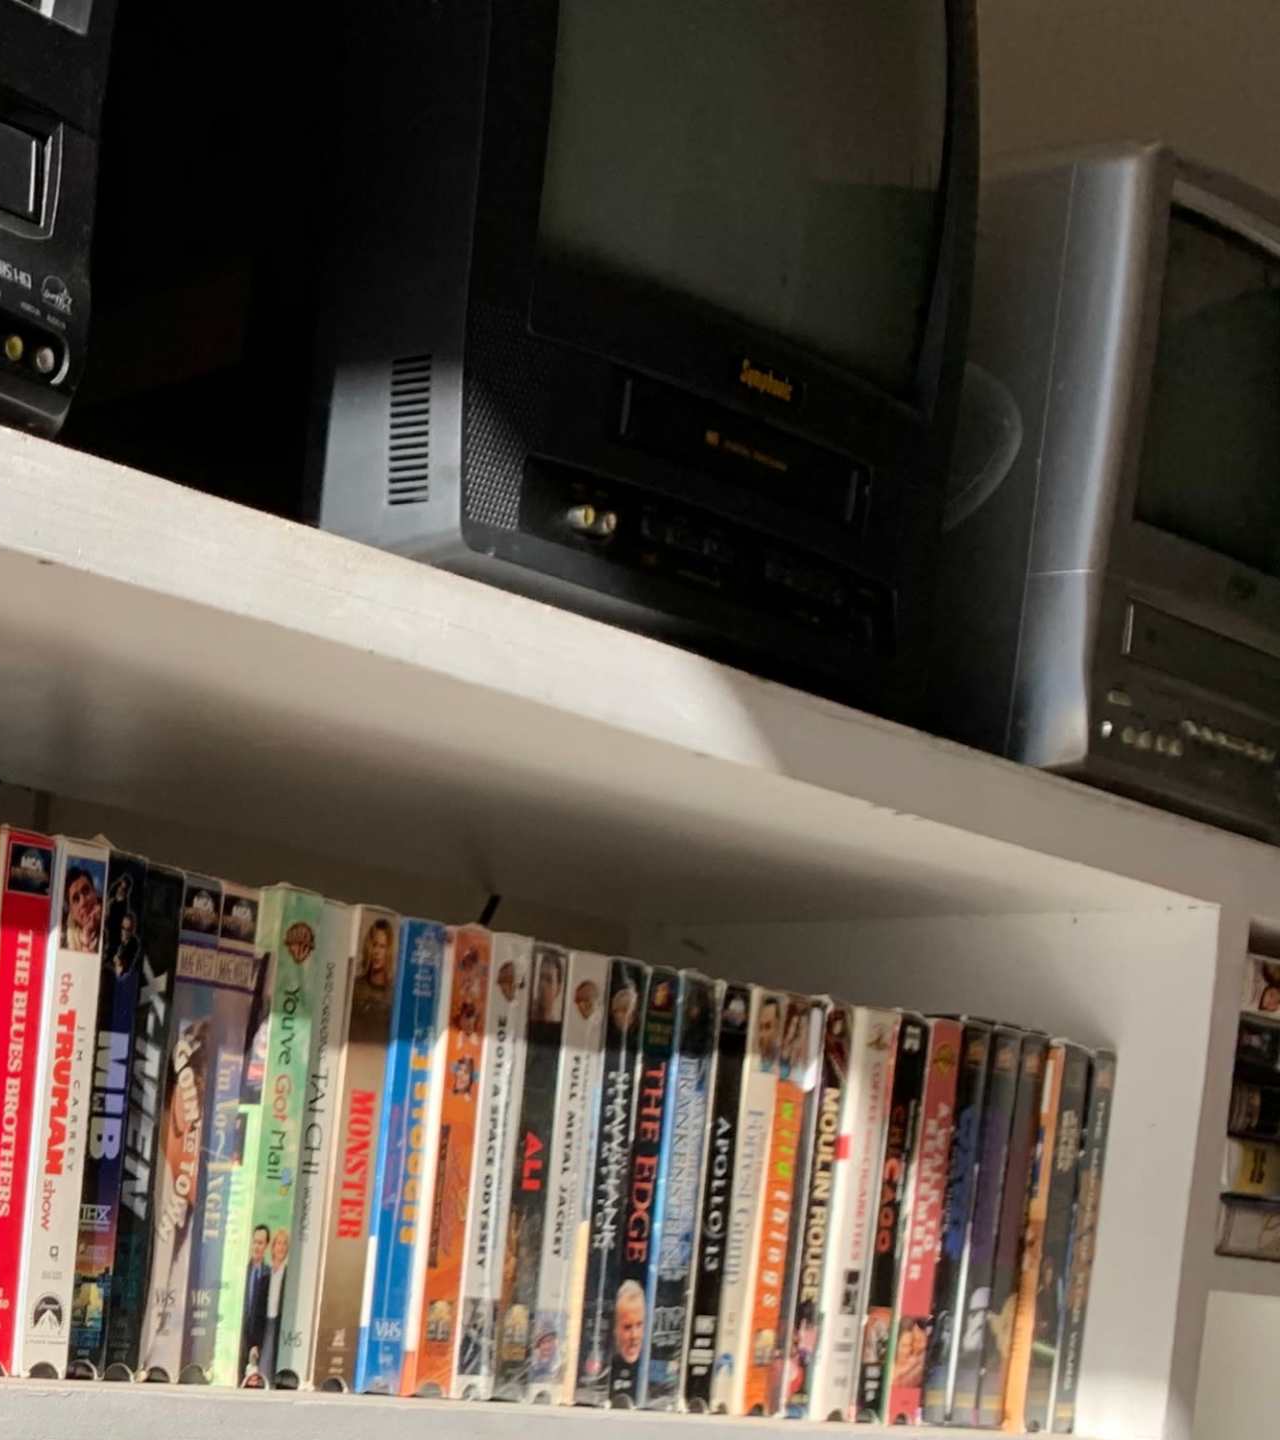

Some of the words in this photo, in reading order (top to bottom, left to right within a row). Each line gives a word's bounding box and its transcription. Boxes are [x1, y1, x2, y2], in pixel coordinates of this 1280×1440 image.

[13, 929, 33, 986] THE
[59, 972, 74, 1005] the
[7, 989, 28, 1073] BLUES
[76, 1024, 87, 1061] JIM
[44, 1010, 77, 1176] TRUMAN
[121, 954, 168, 1221] X-MEN
[271, 1072, 292, 1122] Got
[306, 1072, 329, 1114] TAI
[493, 1082, 502, 1099] A
[569, 1055, 581, 1100] FULL
[640, 1061, 667, 1143] THE
[67, 1079, 80, 1172] CARREY
[266, 1129, 286, 1182] Mail
[301, 1121, 323, 1177] CHI
[485, 1103, 501, 1170] SPACE
[520, 1129, 544, 1192] ALI
[560, 1110, 578, 1176] METAL
[776, 1101, 795, 1178] wild
[812, 1086, 841, 1200] MOULIN
[336, 1088, 377, 1241] MONSTER
[661, 1057, 700, 1272] FRANKENSTEIN
[705, 1115, 732, 1239] APOLLO
[877, 1105, 905, 1254] CHICAGO
[41, 1179, 56, 1232] show
[476, 1172, 494, 1270] ODYSSEY
[552, 1184, 567, 1256] JACKET
[626, 1153, 659, 1264] EDGE
[705, 1245, 720, 1272] 13
[762, 1188, 790, 1309] things
[801, 1204, 831, 1304] ROUGE
[372, 1319, 402, 1341] VHS
